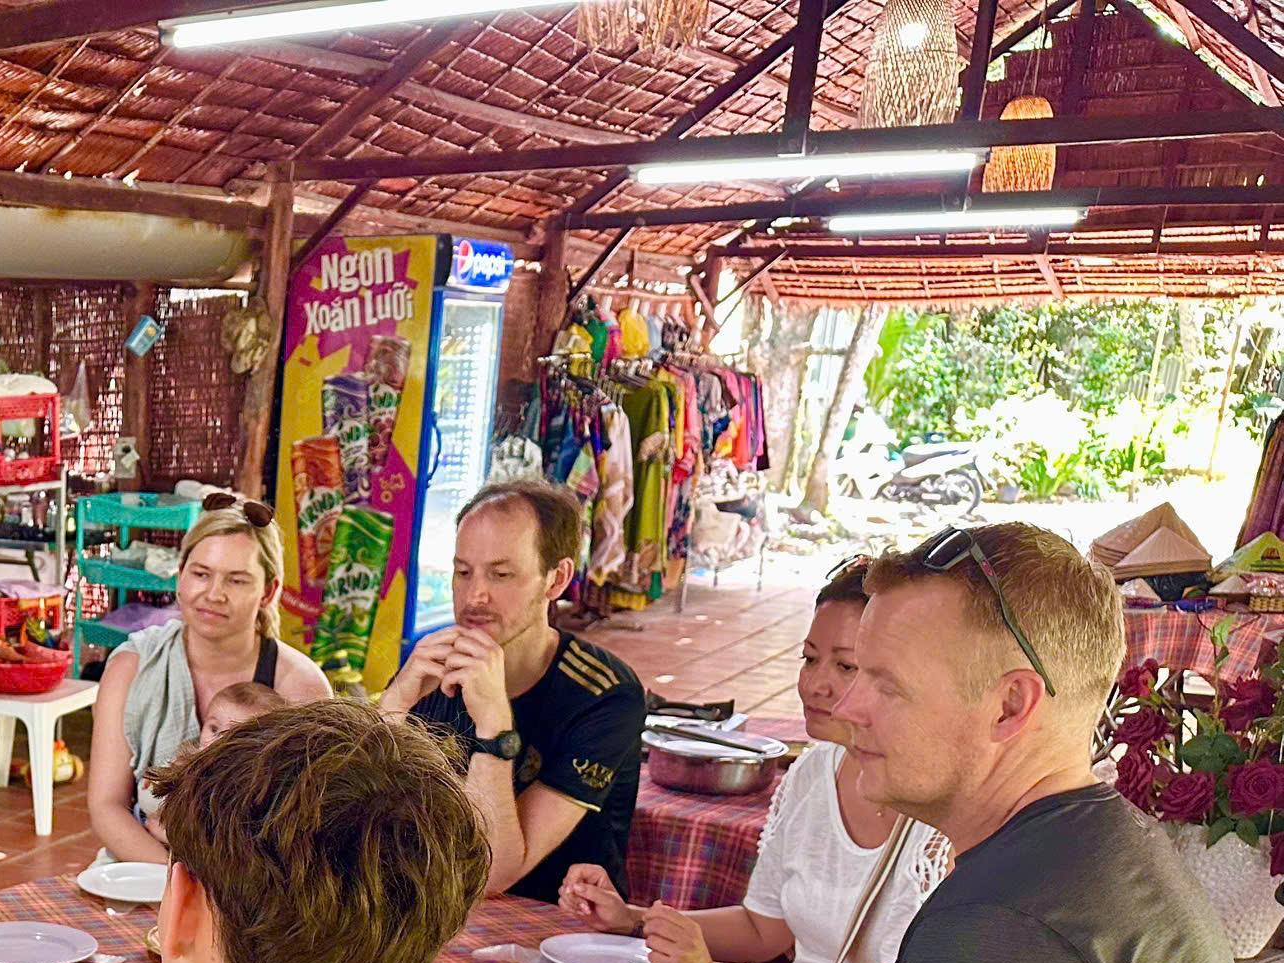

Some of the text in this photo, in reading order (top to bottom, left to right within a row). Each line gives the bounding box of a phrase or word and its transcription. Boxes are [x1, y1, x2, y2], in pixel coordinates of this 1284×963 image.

[319, 246, 395, 293] Ngon
[472, 251, 506, 281] pepsi
[303, 281, 414, 337] Xoắn Lưỡi
